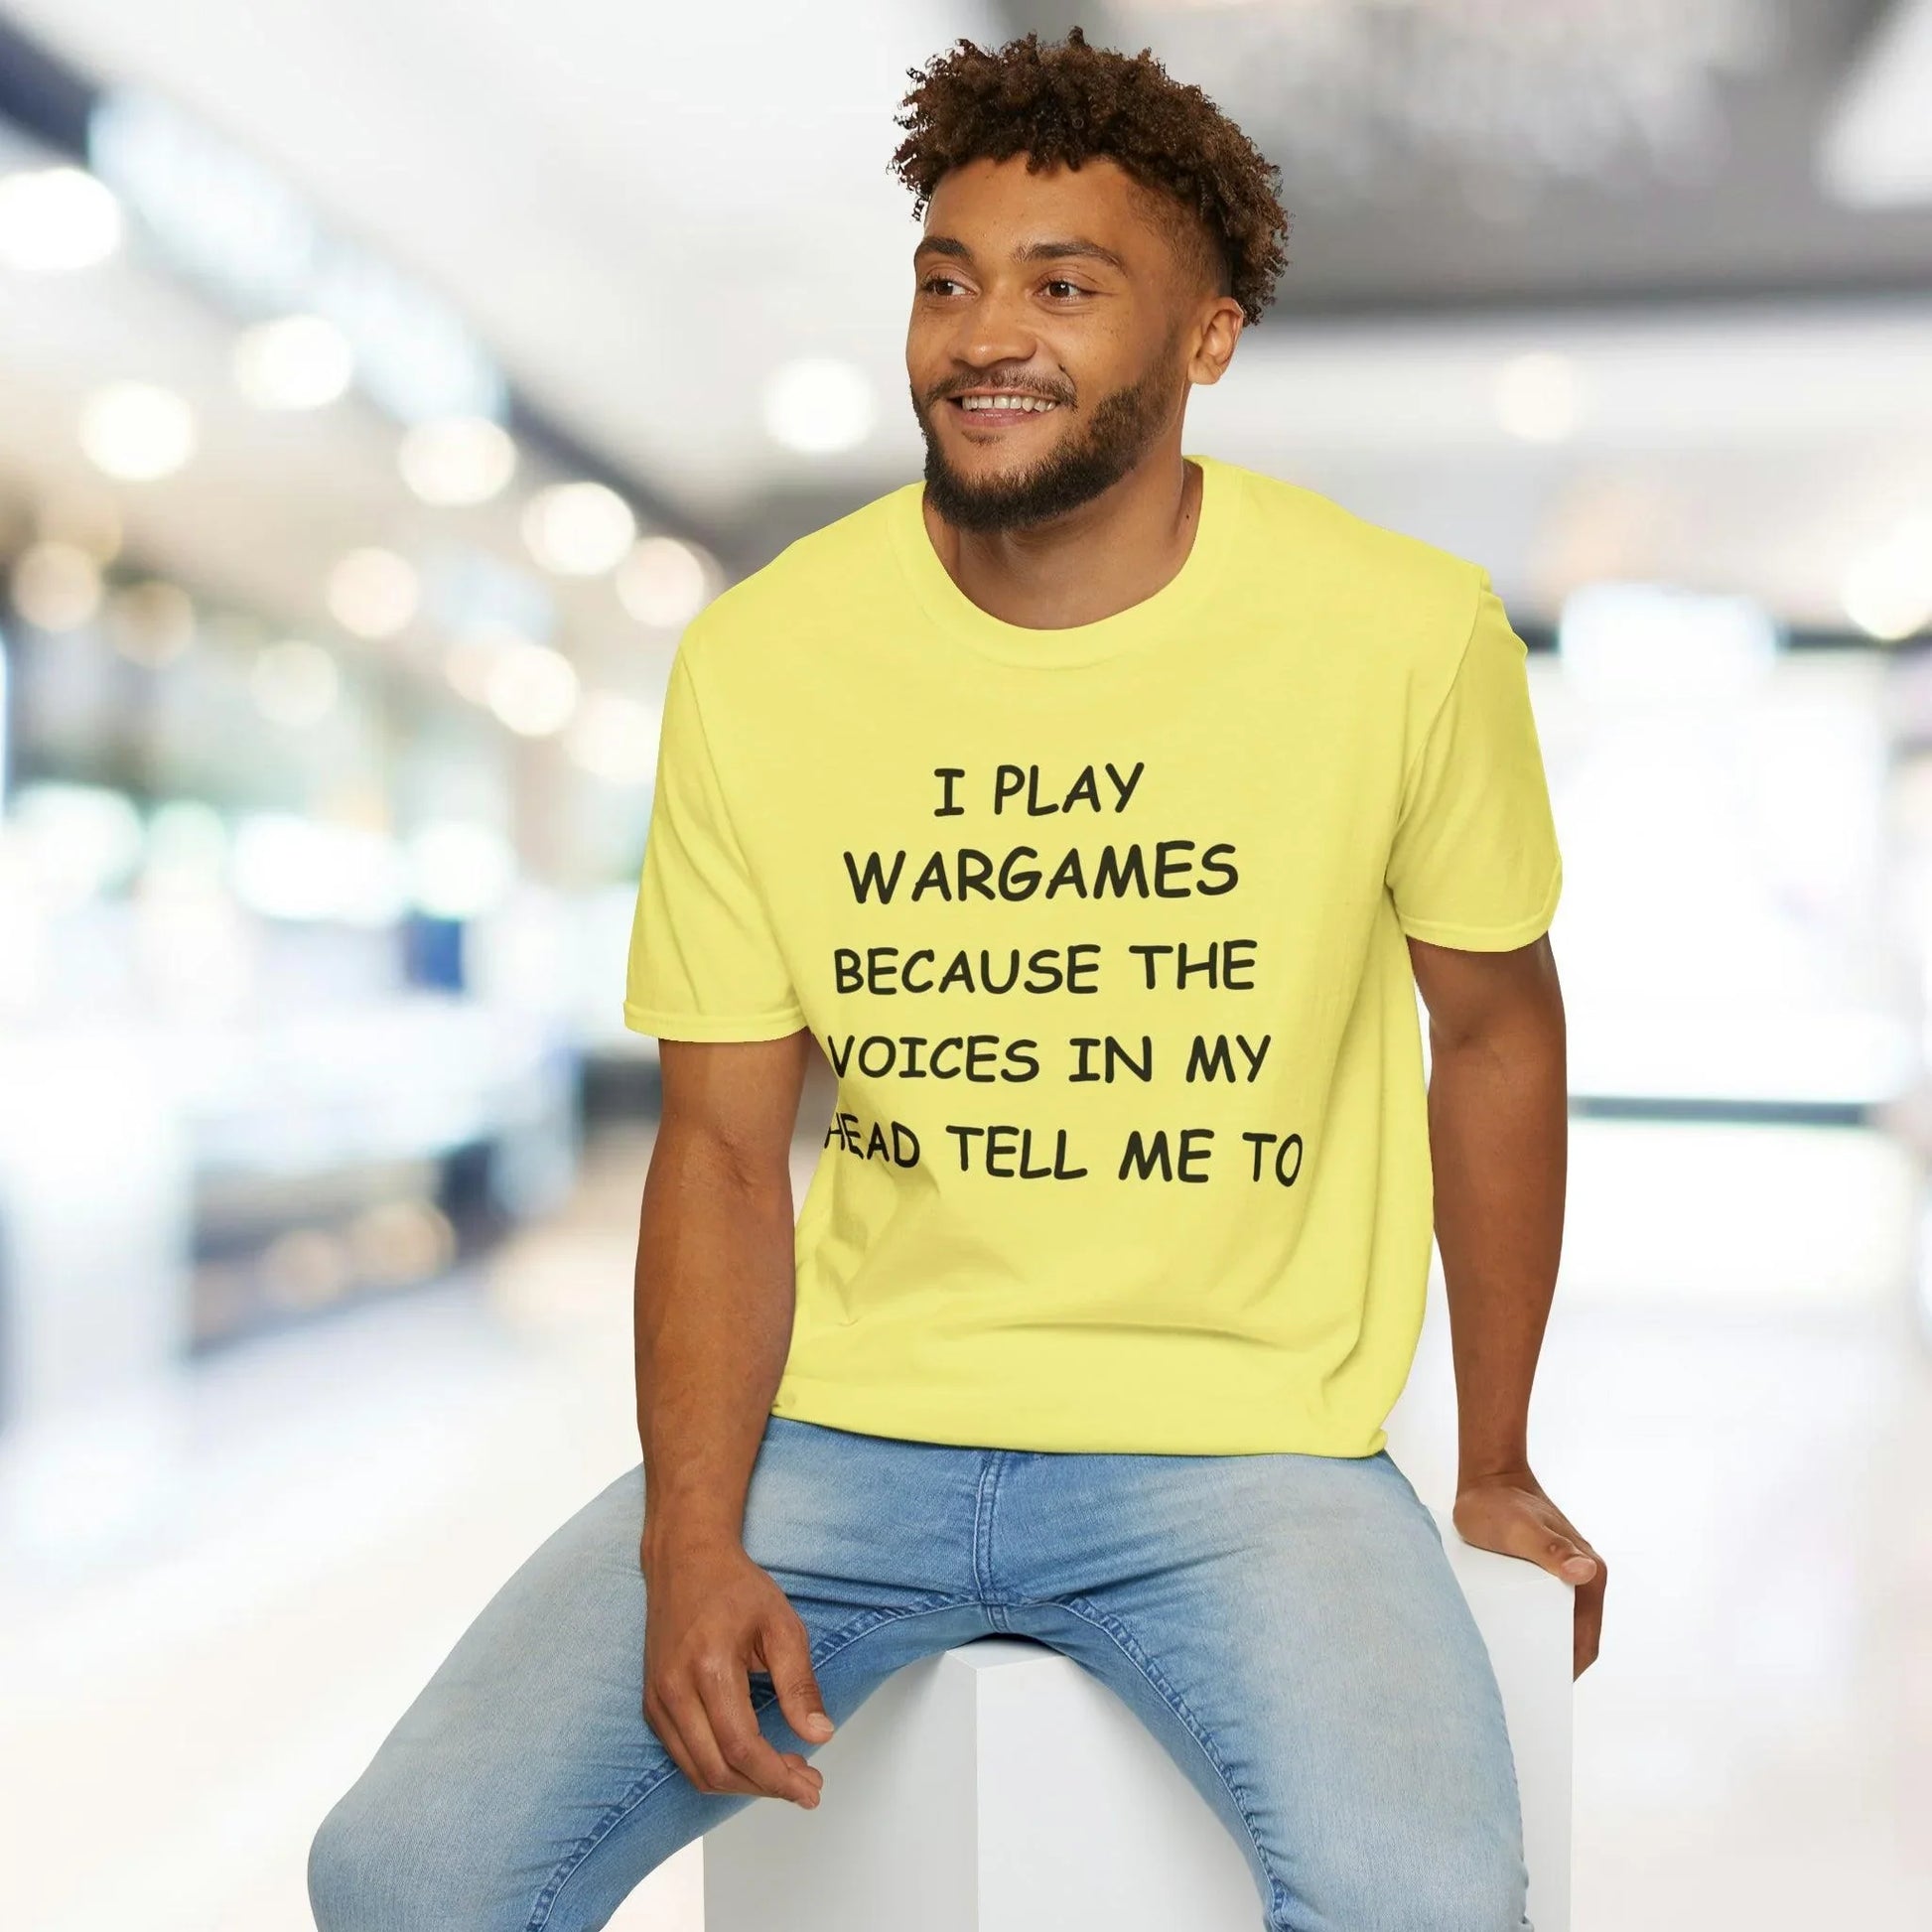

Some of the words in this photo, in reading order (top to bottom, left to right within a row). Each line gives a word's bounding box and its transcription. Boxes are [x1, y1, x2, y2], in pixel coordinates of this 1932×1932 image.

[933, 767, 965, 817] I
[994, 761, 1145, 817] PLAY
[843, 840, 1239, 905] WARGAMES
[834, 944, 1101, 996] BECAUSE
[1128, 939, 1258, 991] THE
[827, 1035, 1039, 1083] VOICES
[1068, 1035, 1153, 1084] IN
[1185, 1035, 1272, 1083] MY
[823, 1112, 920, 1169] HEAD
[945, 1125, 1088, 1180] TELL
[1118, 1128, 1215, 1183] ME
[1242, 1132, 1304, 1187] TO
